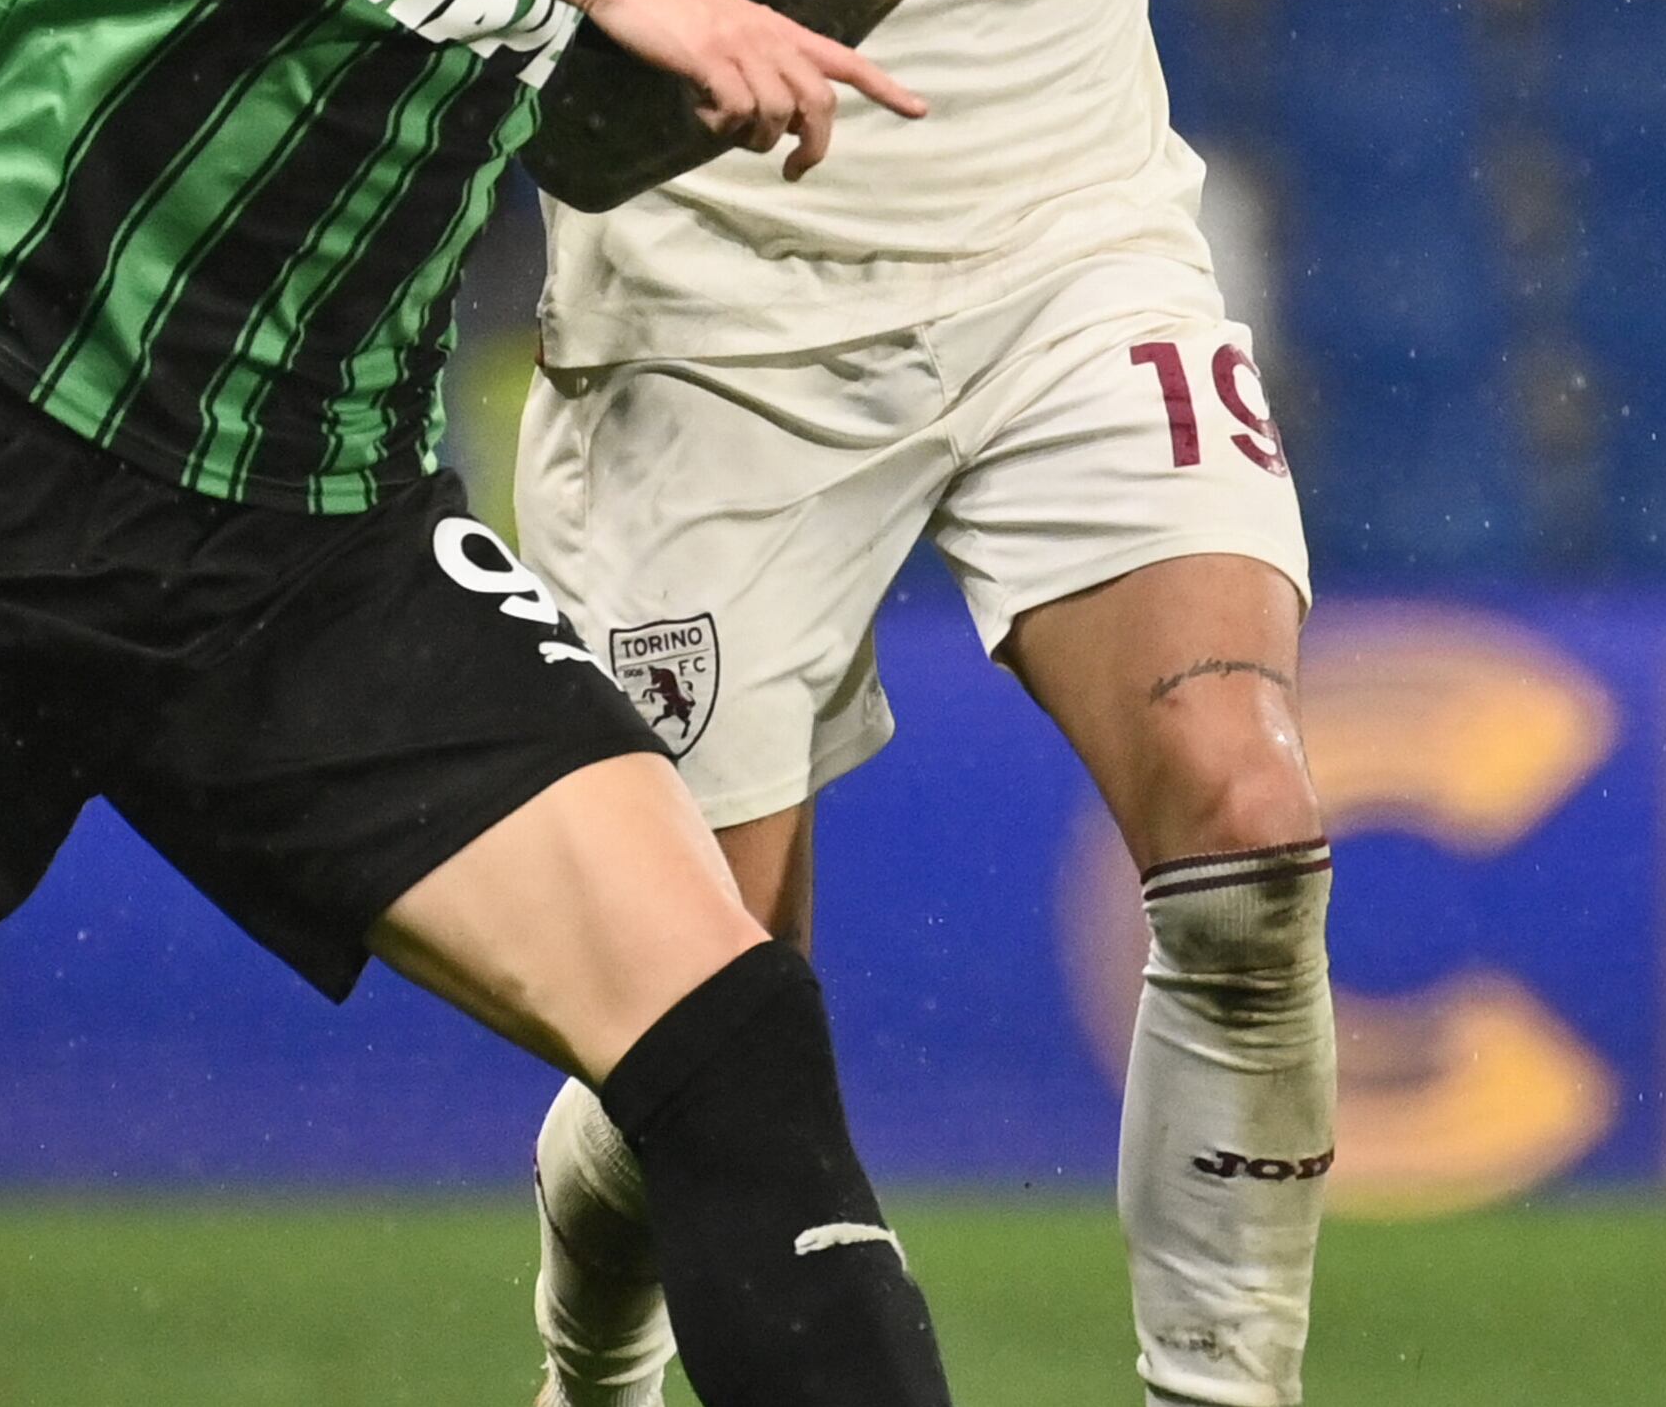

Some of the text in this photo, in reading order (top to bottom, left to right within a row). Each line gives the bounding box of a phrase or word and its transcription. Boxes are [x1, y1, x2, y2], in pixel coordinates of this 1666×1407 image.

[1129, 342, 1288, 478] 19
[433, 517, 560, 625] 9
[621, 627, 703, 658] TORINO
